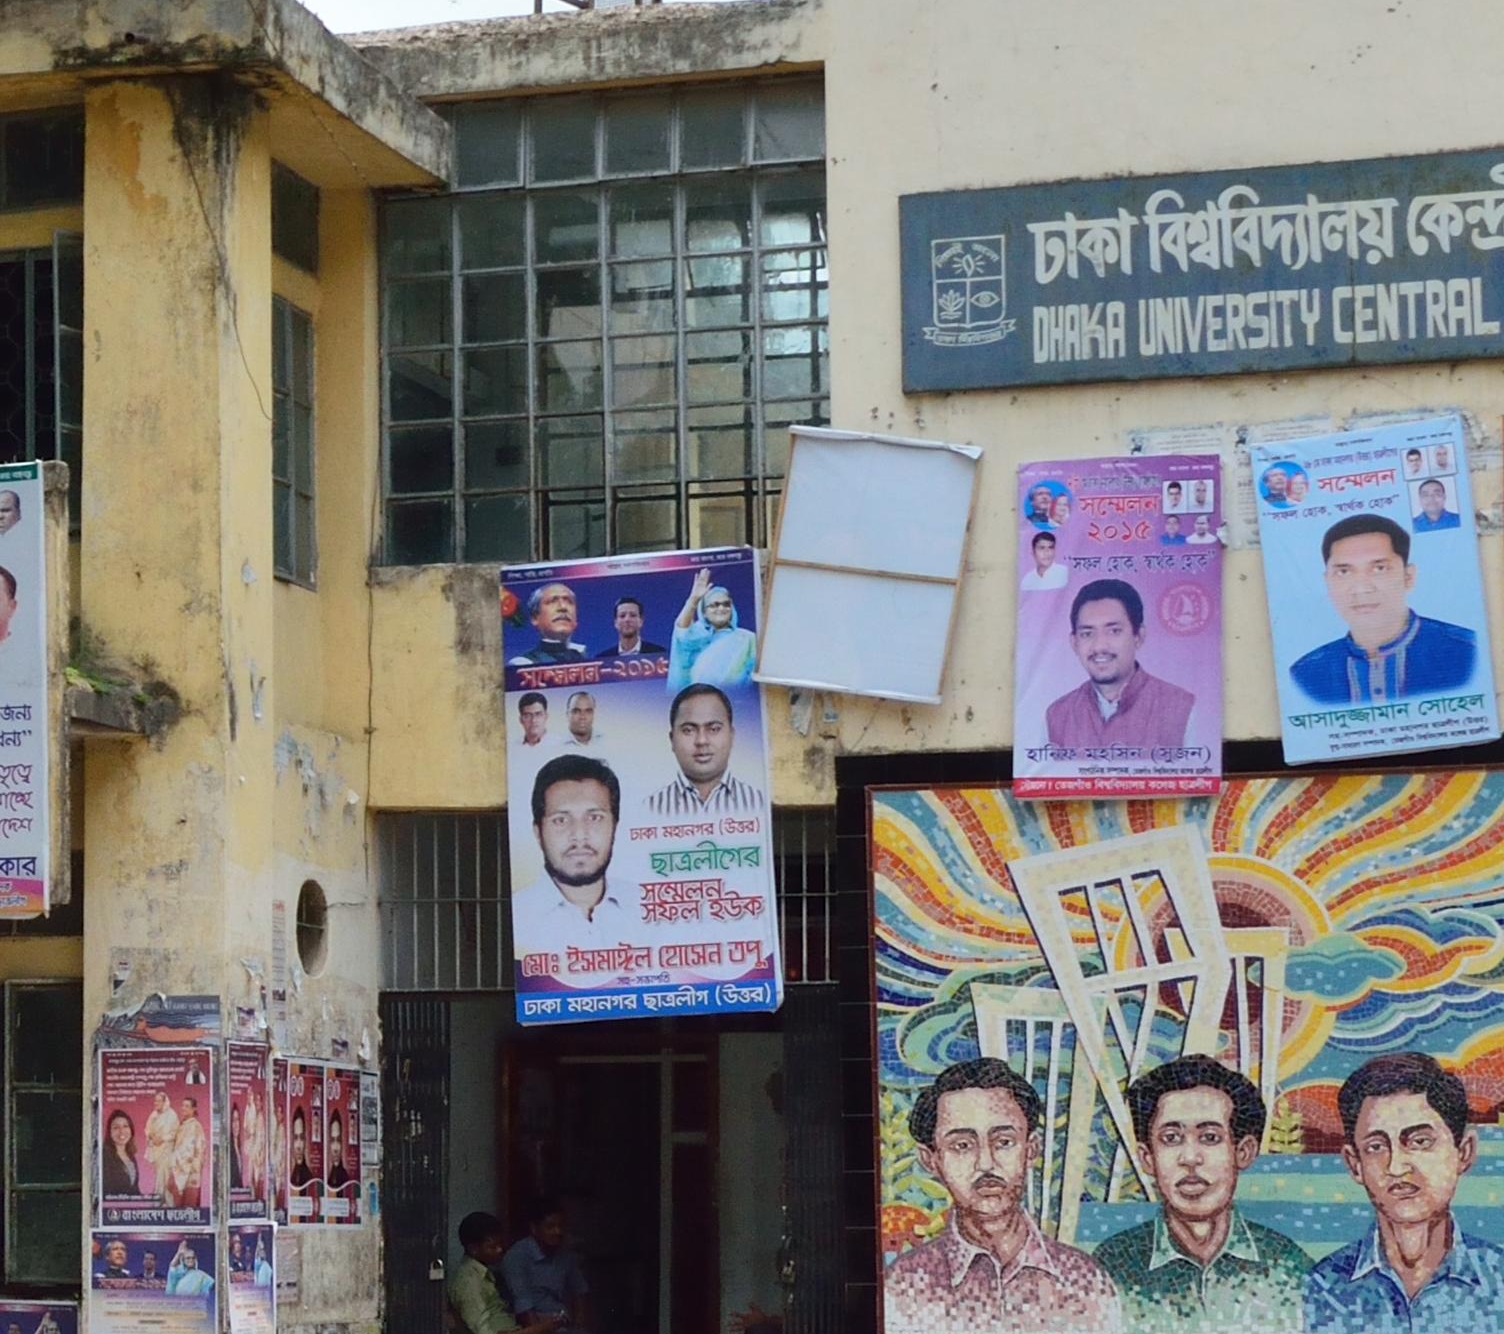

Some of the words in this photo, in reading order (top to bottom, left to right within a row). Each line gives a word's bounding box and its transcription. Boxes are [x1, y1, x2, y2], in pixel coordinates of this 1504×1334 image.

[1027, 208, 1139, 285] ঢাকা
[1143, 184, 1398, 273] বিশ্ববিদ্যালয়
[1032, 301, 1126, 364] DHAKA
[1139, 287, 1321, 357] UNIVERSITY
[1332, 275, 1501, 345] CENTRAL
[1317, 468, 1397, 494] সম্মেলন
[1079, 495, 1161, 516] সম্মেলন
[1088, 520, 1152, 544] ২০১৫
[0, 703, 32, 722] জন্য
[1288, 701, 1409, 730] আসাদুজ্জামান
[1418, 693, 1485, 716] সোহেল
[1085, 742, 1142, 761] মহসিন
[1150, 745, 1212, 764] (সুজন)
[629, 827, 657, 841] ঢাকা
[662, 823, 714, 839] মহানগর
[719, 817, 760, 836] (উত্তর)
[650, 840, 760, 877] ছাত্রলীগের
[640, 900, 700, 922] সফল
[708, 891, 763, 919] হউক
[522, 953, 559, 976] মোঃ
[567, 943, 651, 974] ইসমাঈল
[659, 942, 721, 970] হোসেন
[727, 939, 768, 968] তপু
[523, 997, 560, 1016] ঢাকা
[567, 993, 637, 1013] মহানগর
[643, 986, 708, 1011] ছাত্রলীগ
[715, 982, 772, 1006] (উত্তর)
